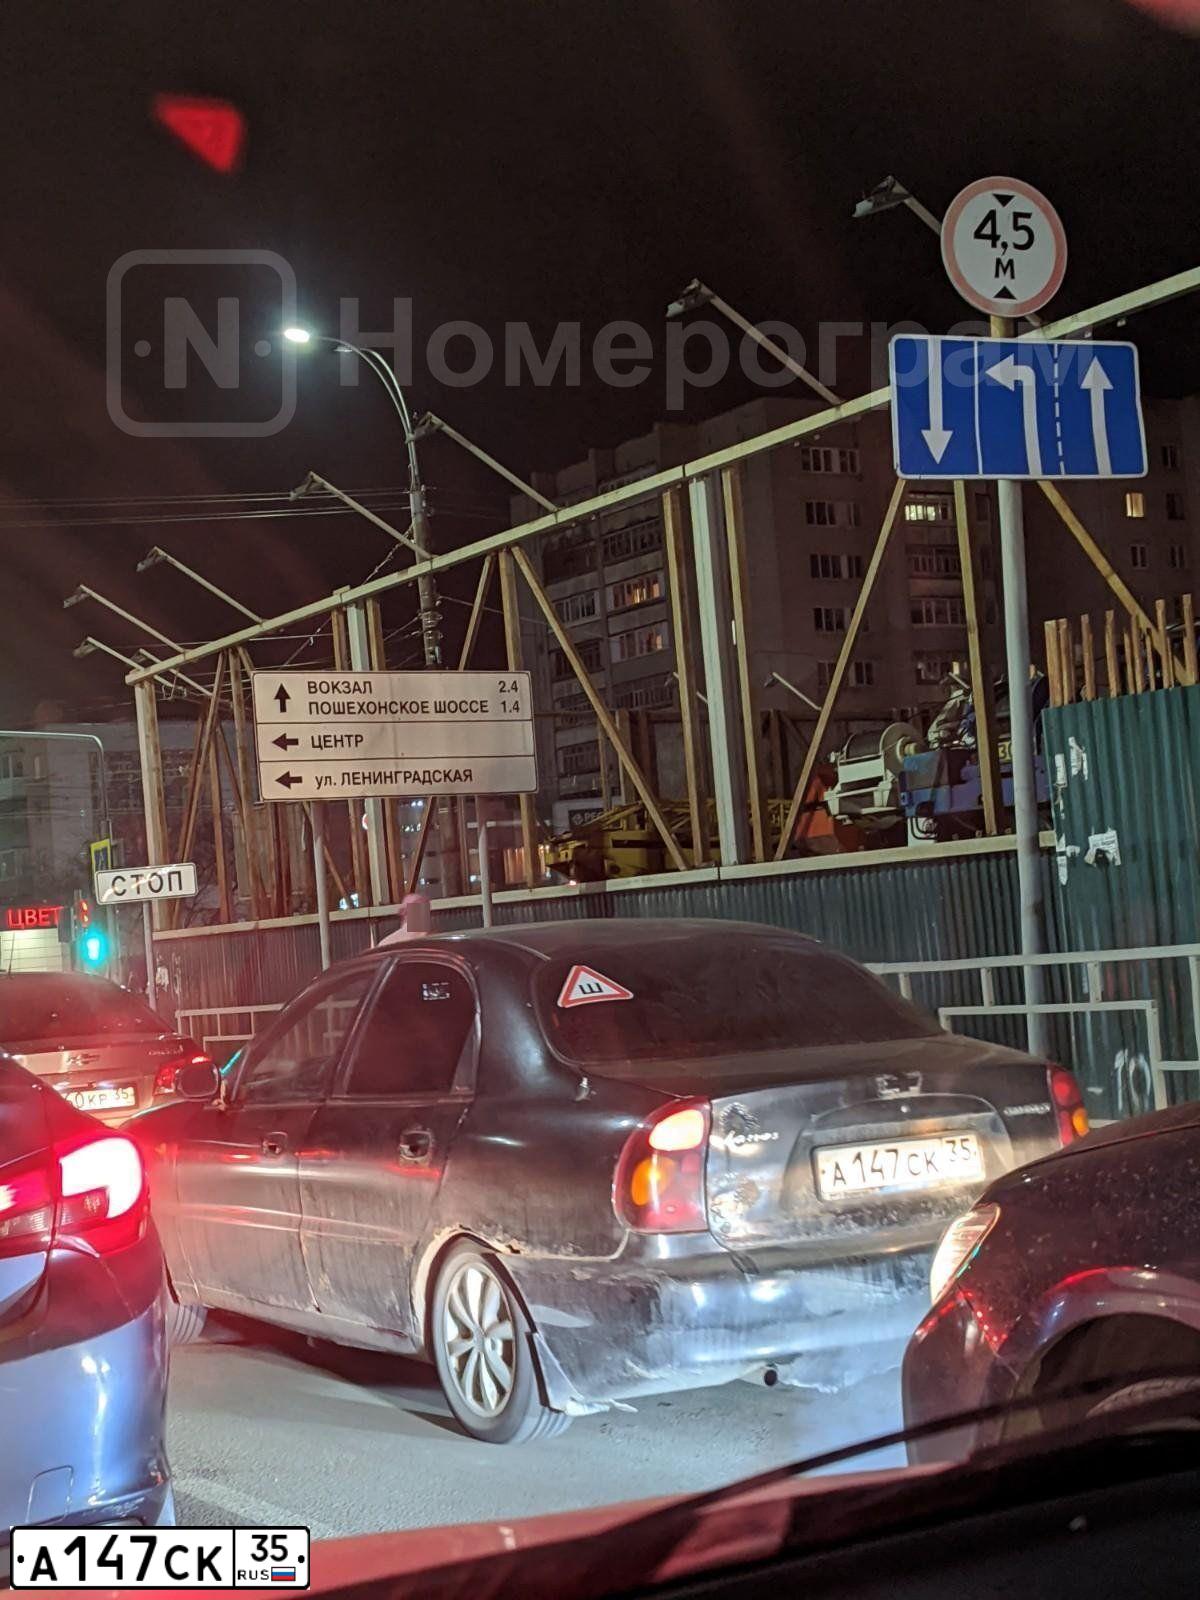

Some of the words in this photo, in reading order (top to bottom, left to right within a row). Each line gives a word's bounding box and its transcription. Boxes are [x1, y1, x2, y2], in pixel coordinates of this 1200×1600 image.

[973, 208, 1035, 256] 4,5
[994, 257, 1015, 280] М
[307, 680, 373, 695] ВОКЗАЛ
[498, 680, 519, 693] 2.4
[308, 700, 430, 716] ПОШЕХОНСКОЕ
[434, 699, 489, 714] ШОССЕ
[500, 700, 520, 713] 1.4
[311, 734, 364, 750] ЦЕНТР
[315, 775, 337, 790] ул.
[340, 768, 473, 786] ЛЕНИНГРАДСКАЯ
[111, 870, 183, 897] СТОП
[945, 1137, 972, 1162] 35
